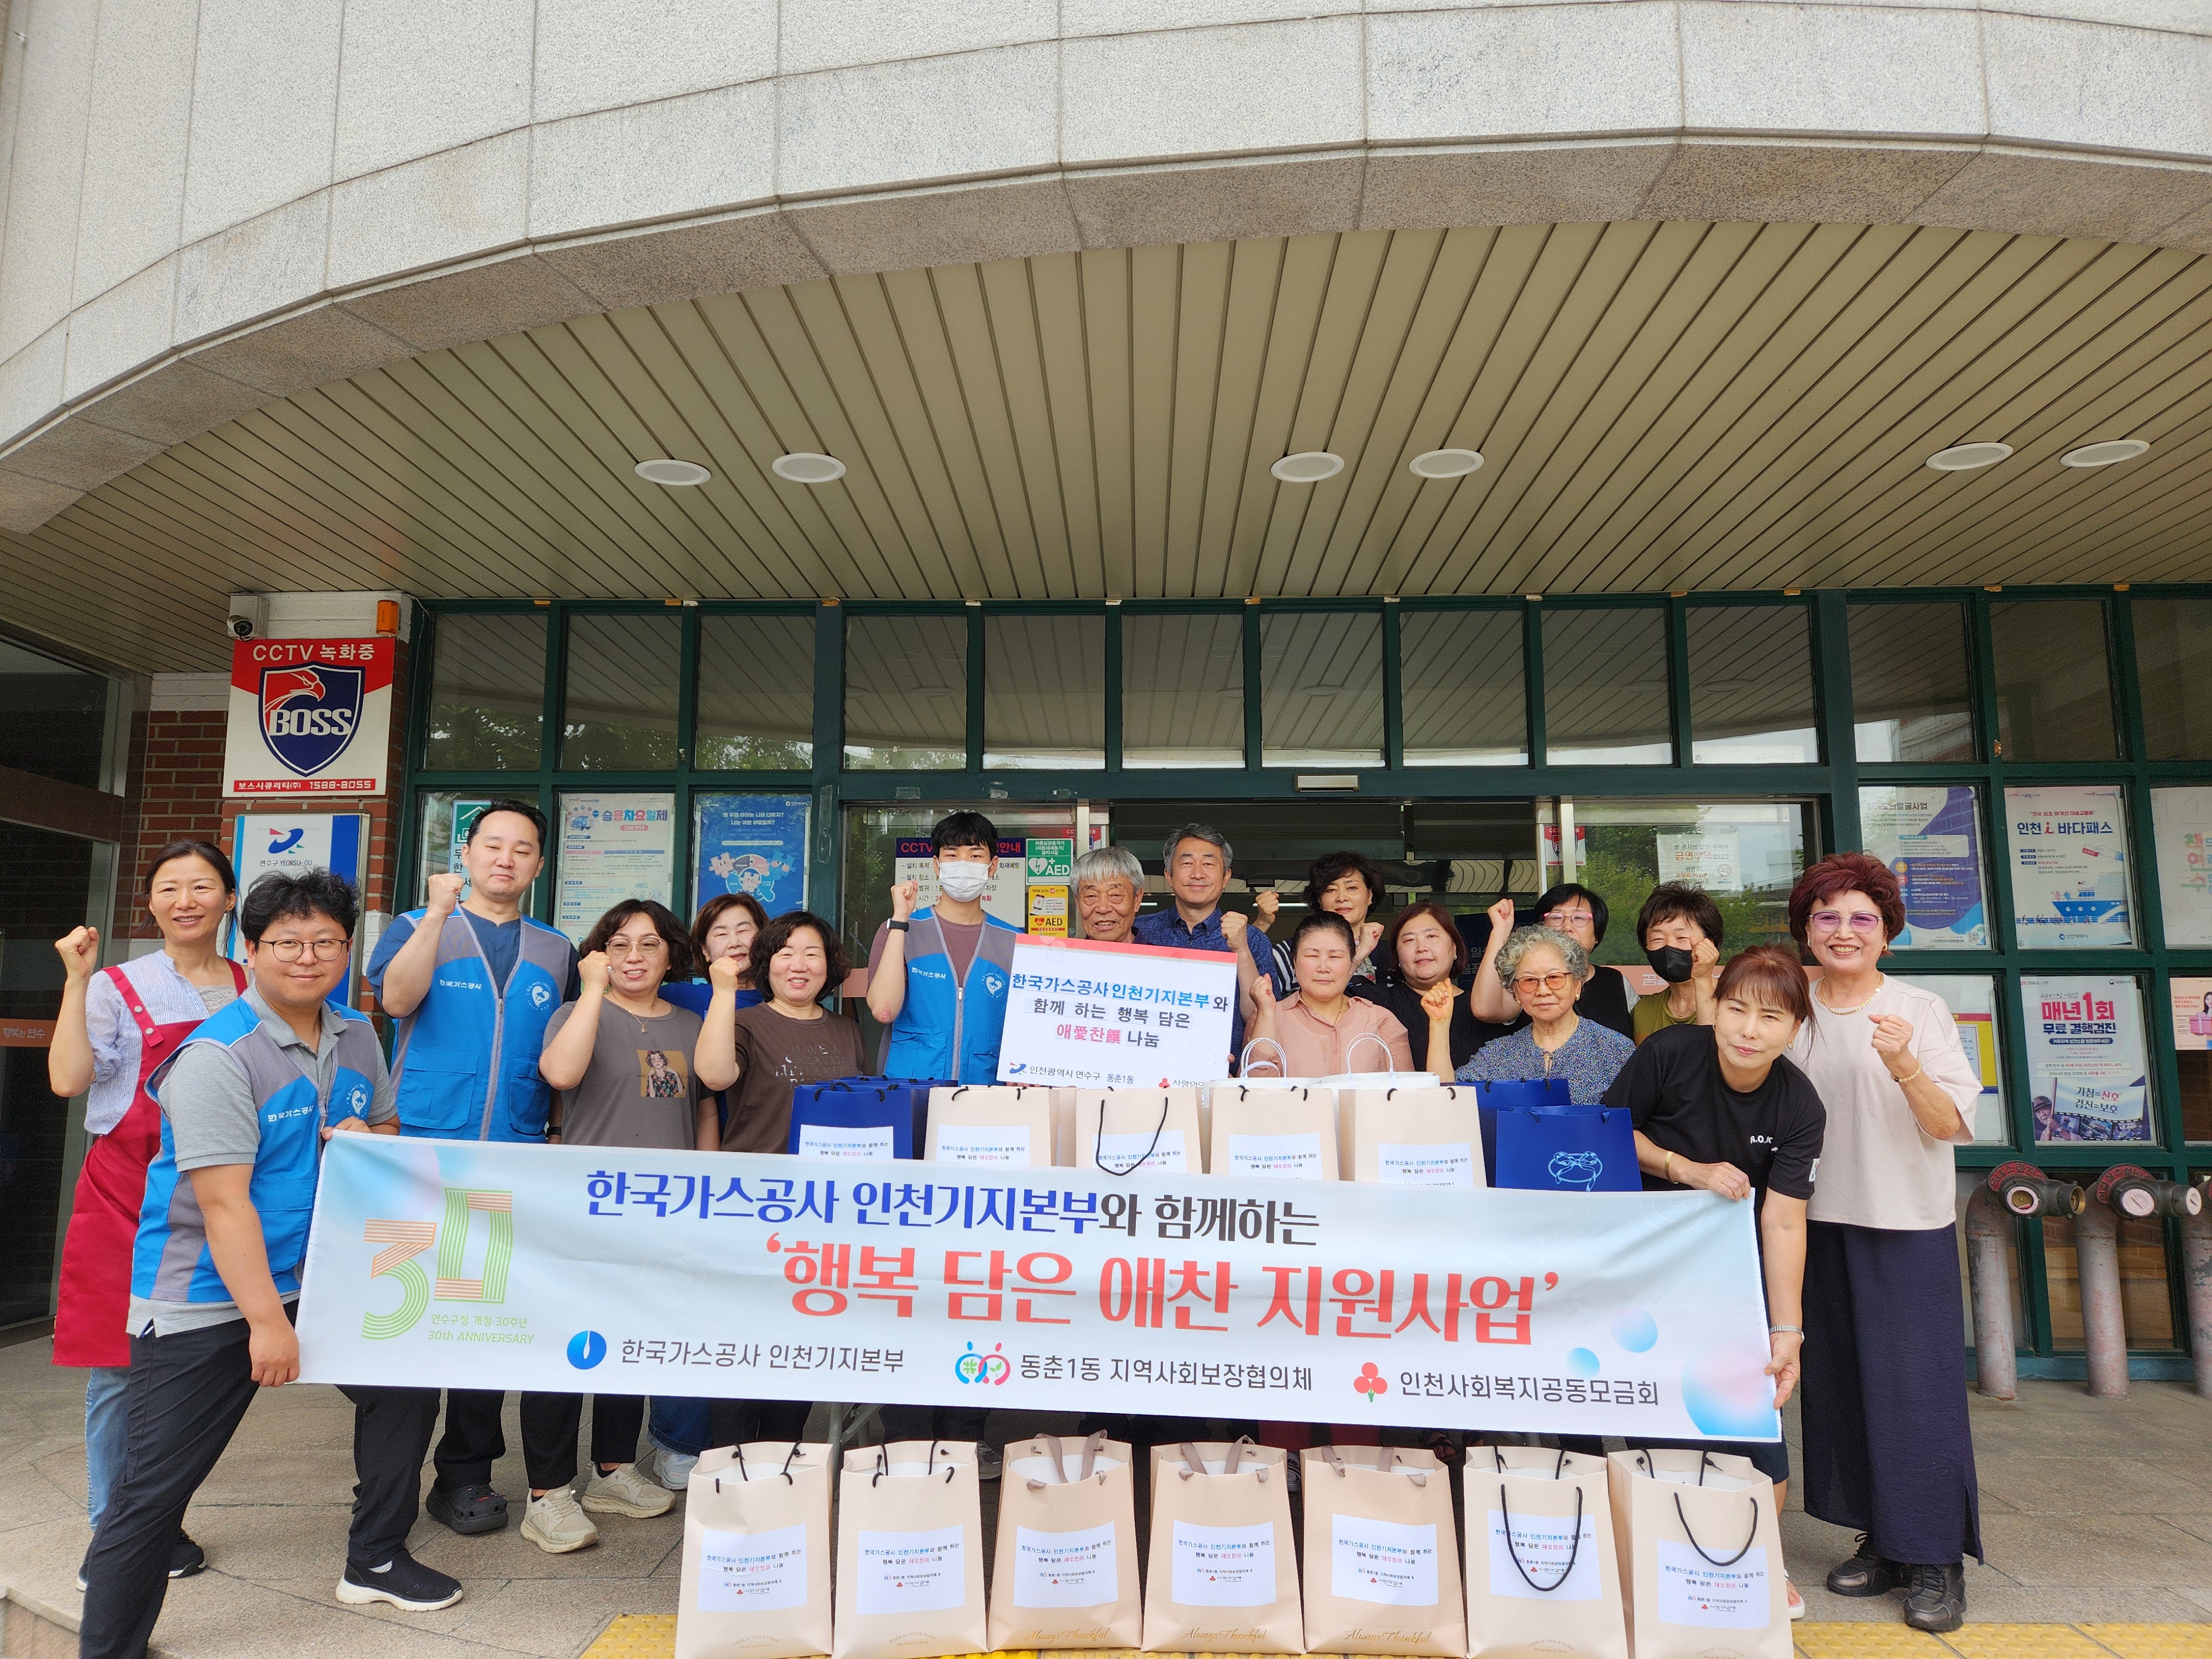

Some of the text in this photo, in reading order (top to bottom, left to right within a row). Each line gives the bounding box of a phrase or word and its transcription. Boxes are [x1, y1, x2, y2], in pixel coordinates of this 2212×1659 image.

[253, 644, 374, 661] CCTV 녹화중
[269, 708, 352, 735] BOSS
[310, 780, 371, 789] 1588-8055
[602, 810, 667, 821] 승용차요일제
[2017, 822, 2042, 834] 인천
[2058, 822, 2113, 834] 바다패스
[901, 843, 933, 853] CCTV
[1046, 865, 1070, 875] AED
[912, 967, 946, 979] 한국가스공사
[440, 979, 482, 989] 한국가스공사
[1034, 998, 1190, 1028] 함께 하는 행복 담은
[3, 1027, 45, 1039] 행복한 연수
[2043, 1022, 2116, 1034] 무료 결핵검진
[1128, 1030, 1160, 1048] 나눔
[1030, 1066, 1134, 1084] 인천광역시 연수구 동춘1동
[268, 1105, 314, 1122] 한국가스공사
[587, 1170, 1319, 1246] 한국가스공사 인천기지본부와 함께하는
[943, 1250, 1077, 1325] 담은
[1099, 1256, 1239, 1332] 애찬
[431, 1313, 527, 1328] 연수구청 개청 30주년
[428, 1331, 534, 1344] 30th ANNIVERSARY
[621, 1339, 905, 1373] 한국가스공사 인천기지본부
[1020, 1354, 1312, 1391] 동춘1동 지역사회보장협의체
[1400, 1371, 1660, 1406] 인천사회복지공동모금회
[1024, 1627, 1111, 1644] Always Thankful
[1182, 1627, 1267, 1642] Always Thankful
[1344, 1629, 1432, 1645] Always Thankful
